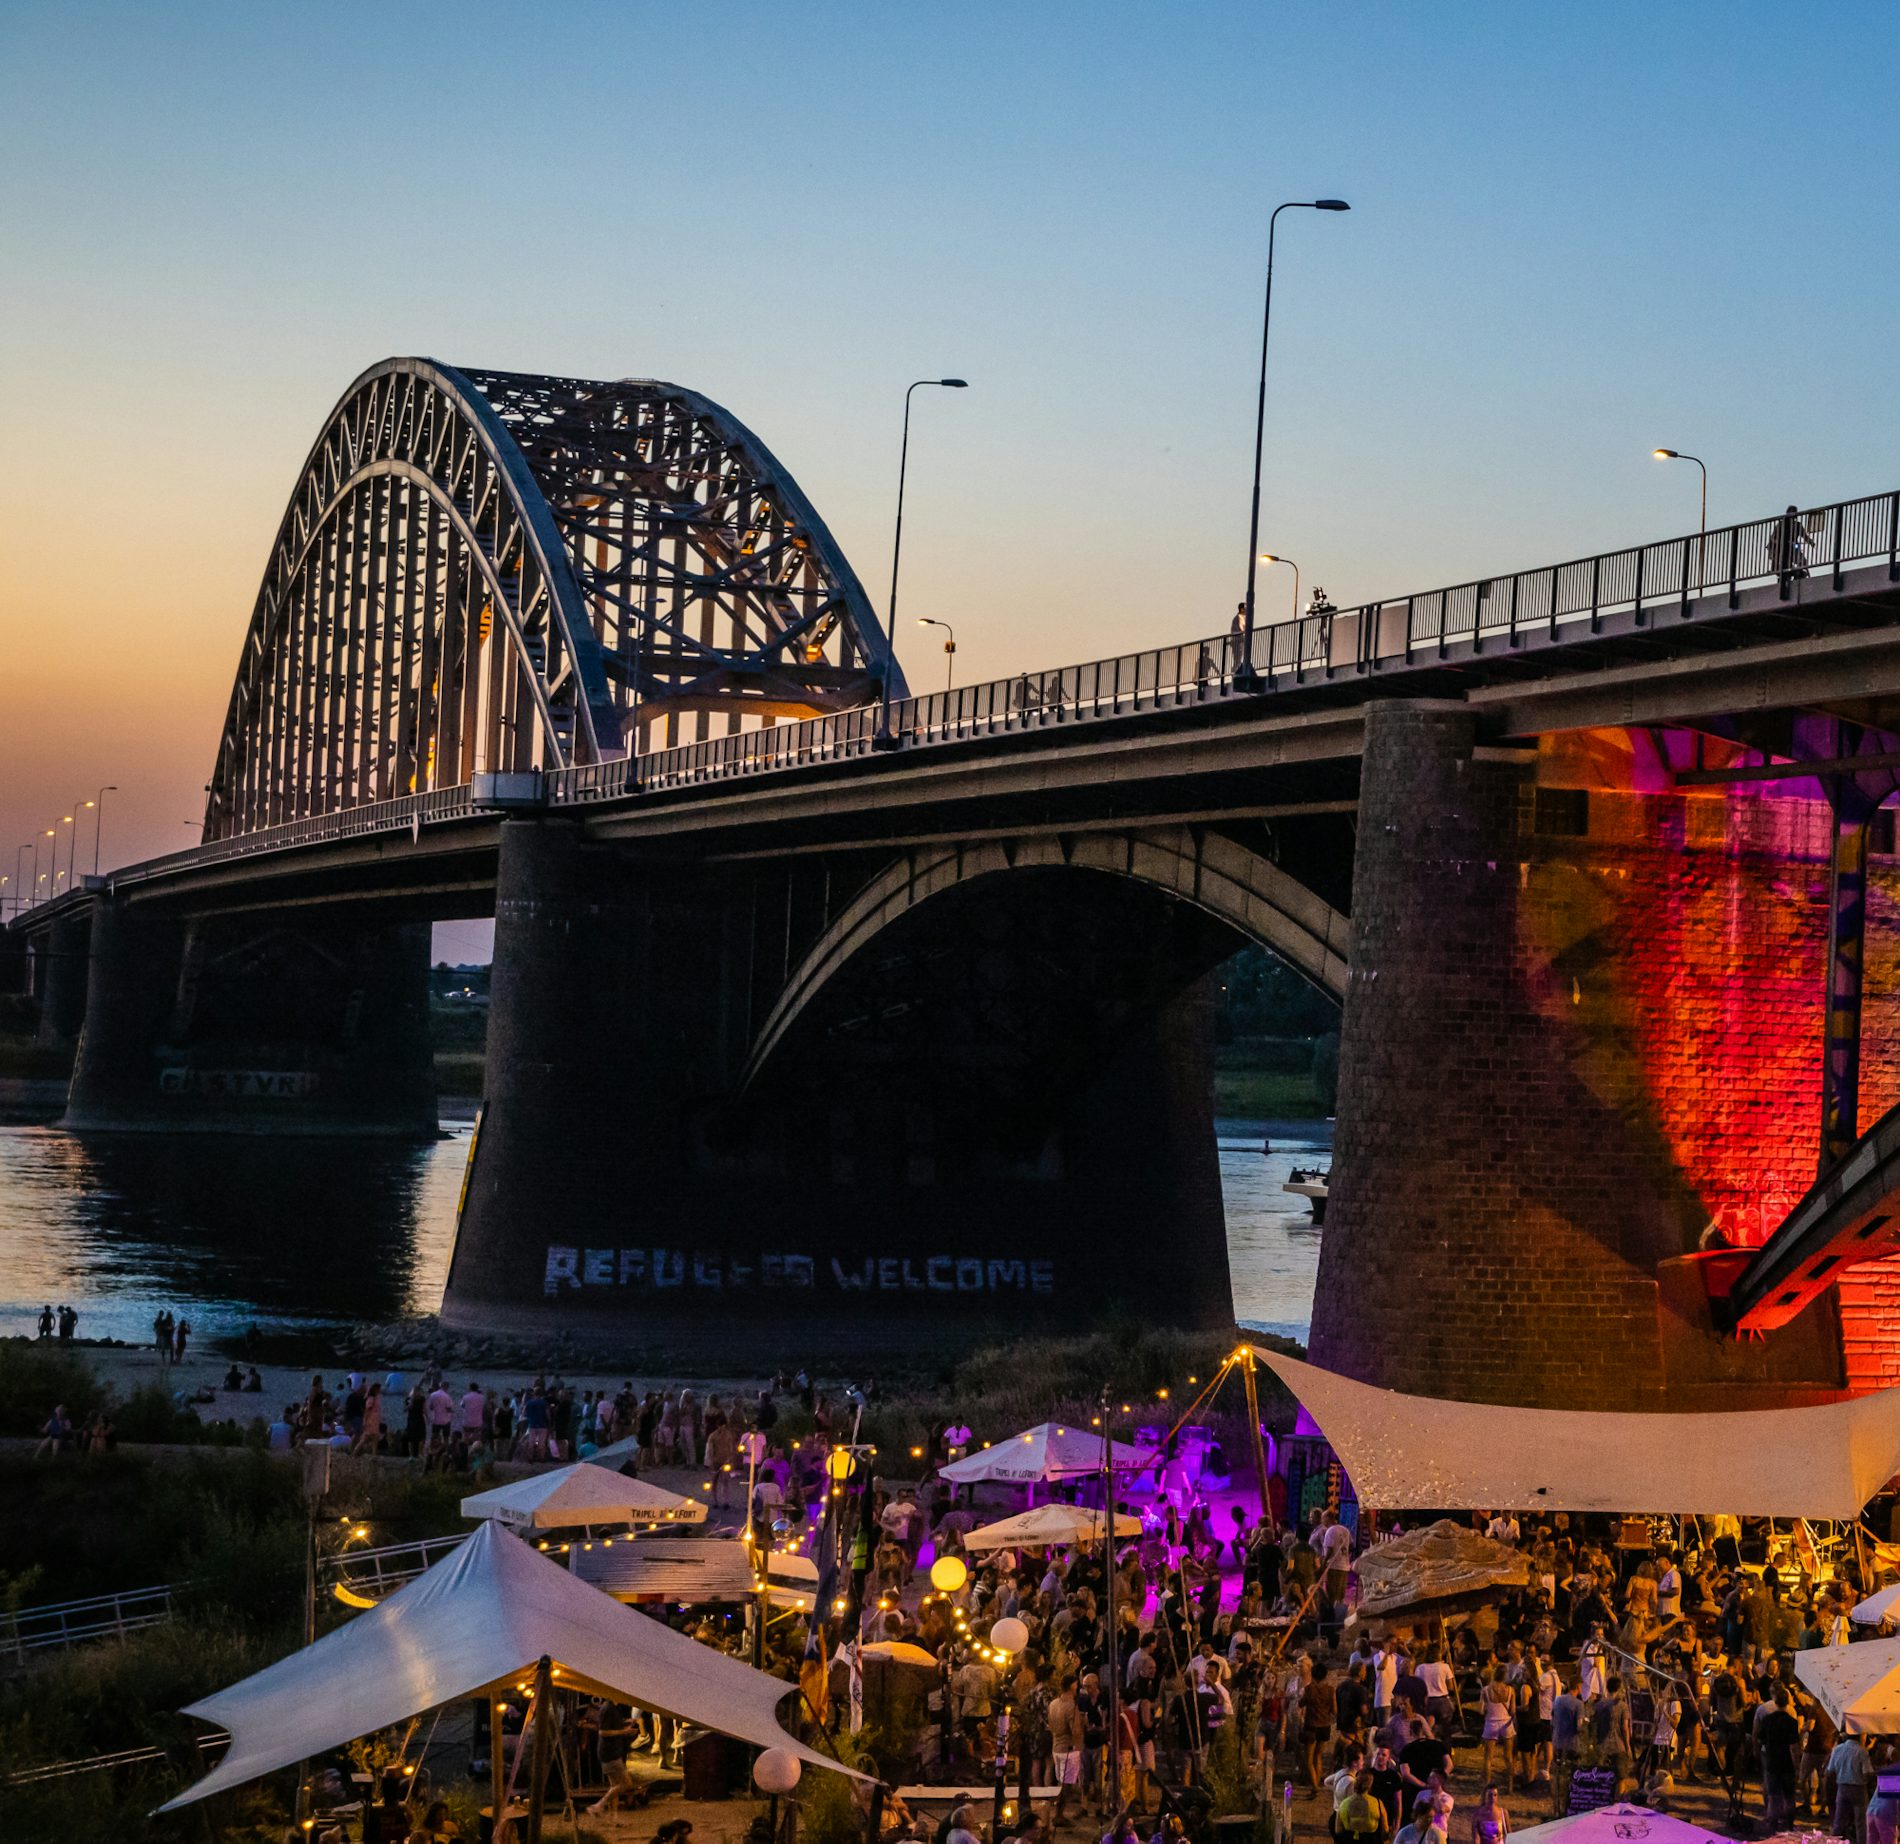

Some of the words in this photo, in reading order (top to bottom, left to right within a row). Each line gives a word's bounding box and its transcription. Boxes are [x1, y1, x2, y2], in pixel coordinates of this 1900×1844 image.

[831, 1254, 1053, 1296] WELCOME
[632, 1509, 656, 1519] TRIPEL
[669, 1509, 697, 1519] EFORT
